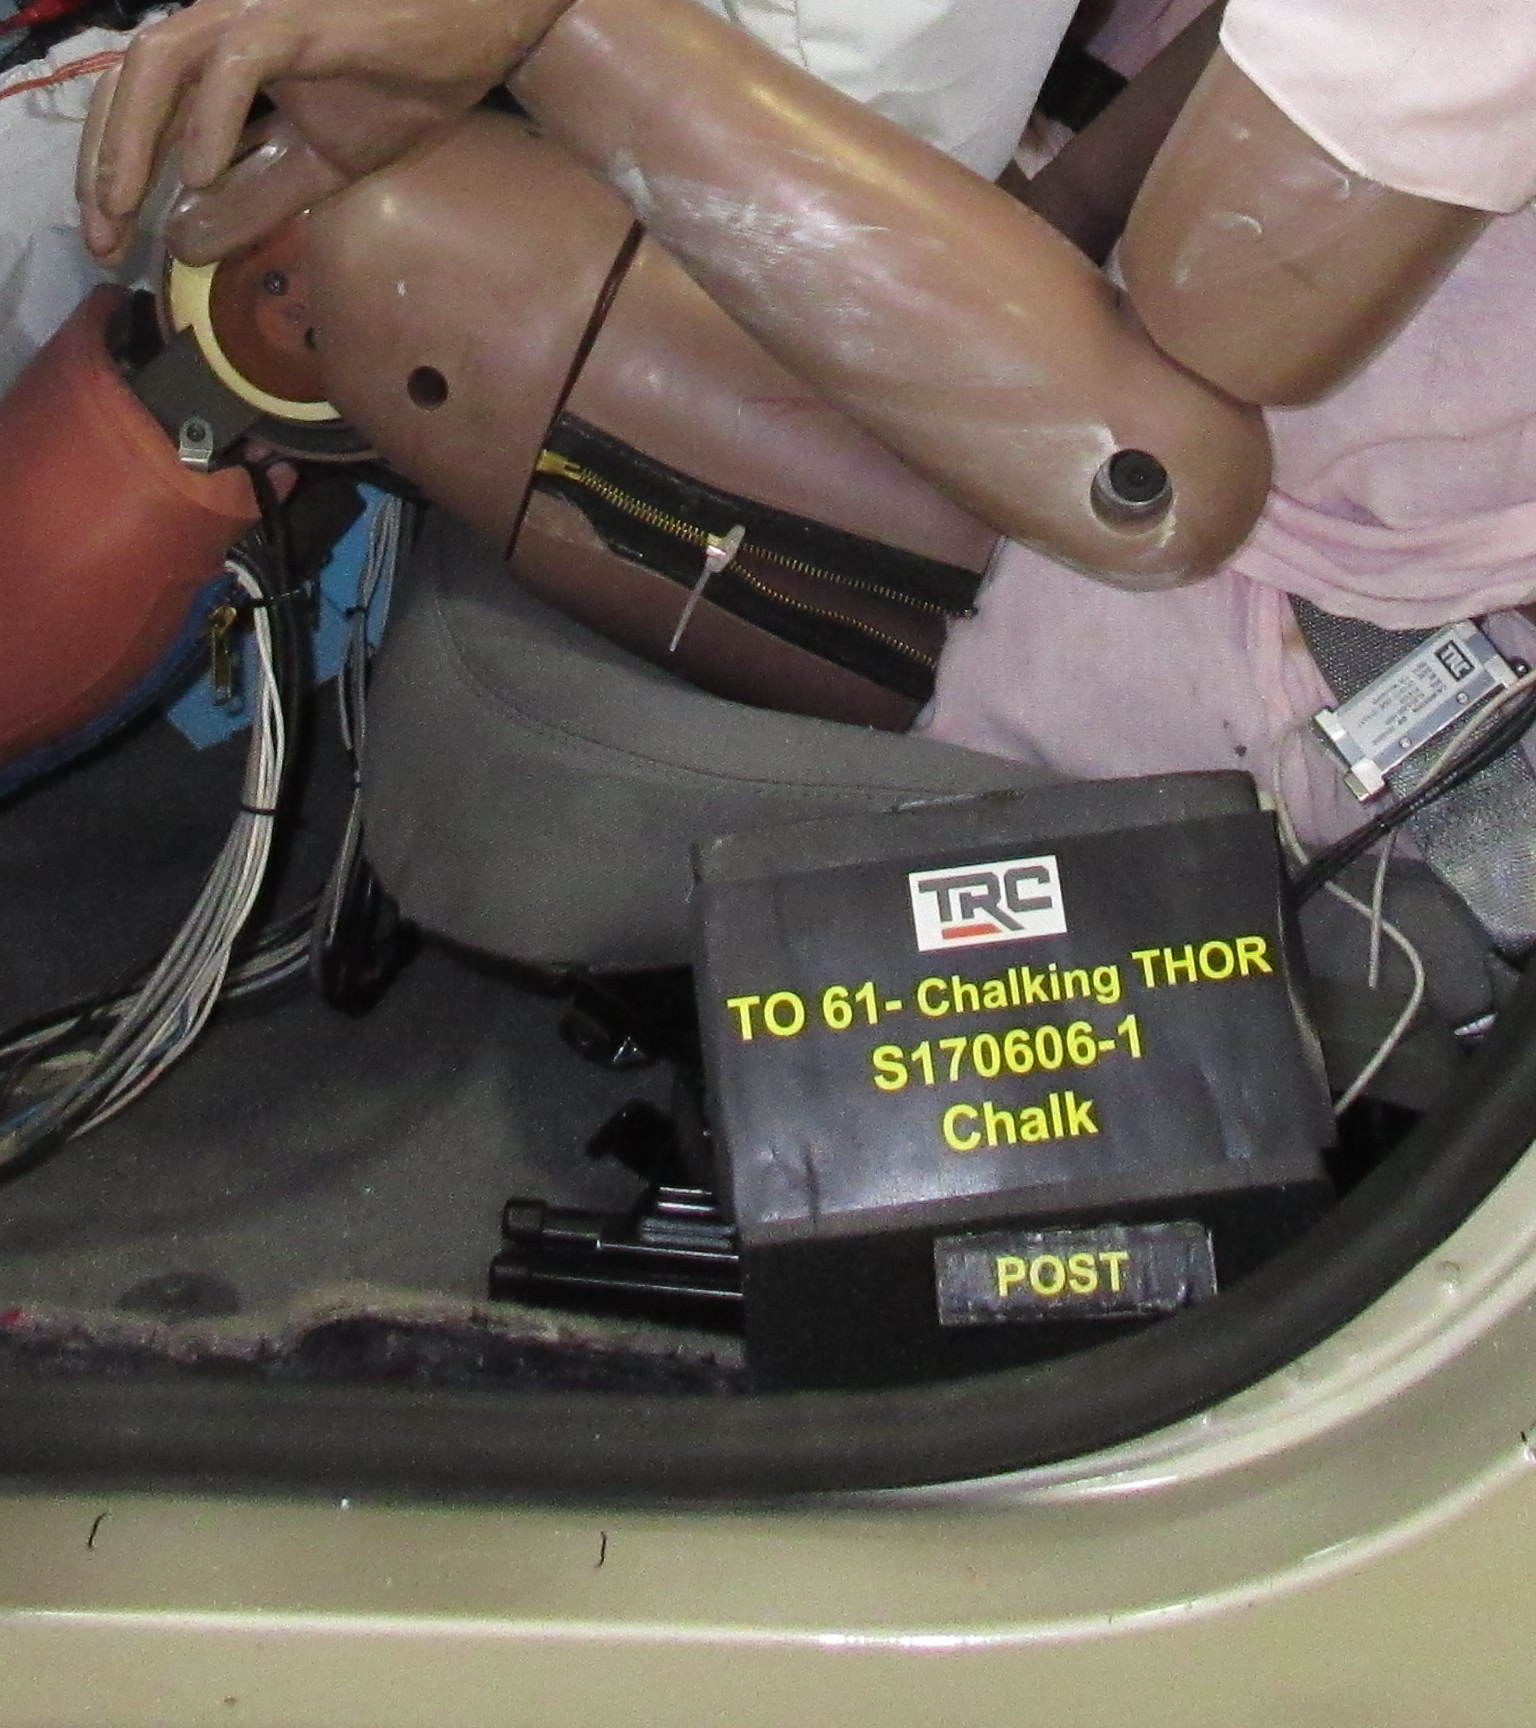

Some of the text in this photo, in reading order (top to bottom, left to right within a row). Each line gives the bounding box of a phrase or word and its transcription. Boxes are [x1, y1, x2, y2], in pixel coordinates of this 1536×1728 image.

[918, 864, 1053, 931] TRC
[727, 935, 1273, 1041] TO 61- Chalking THOR
[871, 1016, 1143, 1090] S170606-1
[942, 1091, 1098, 1151] Chalk
[994, 1251, 1129, 1297] POST
